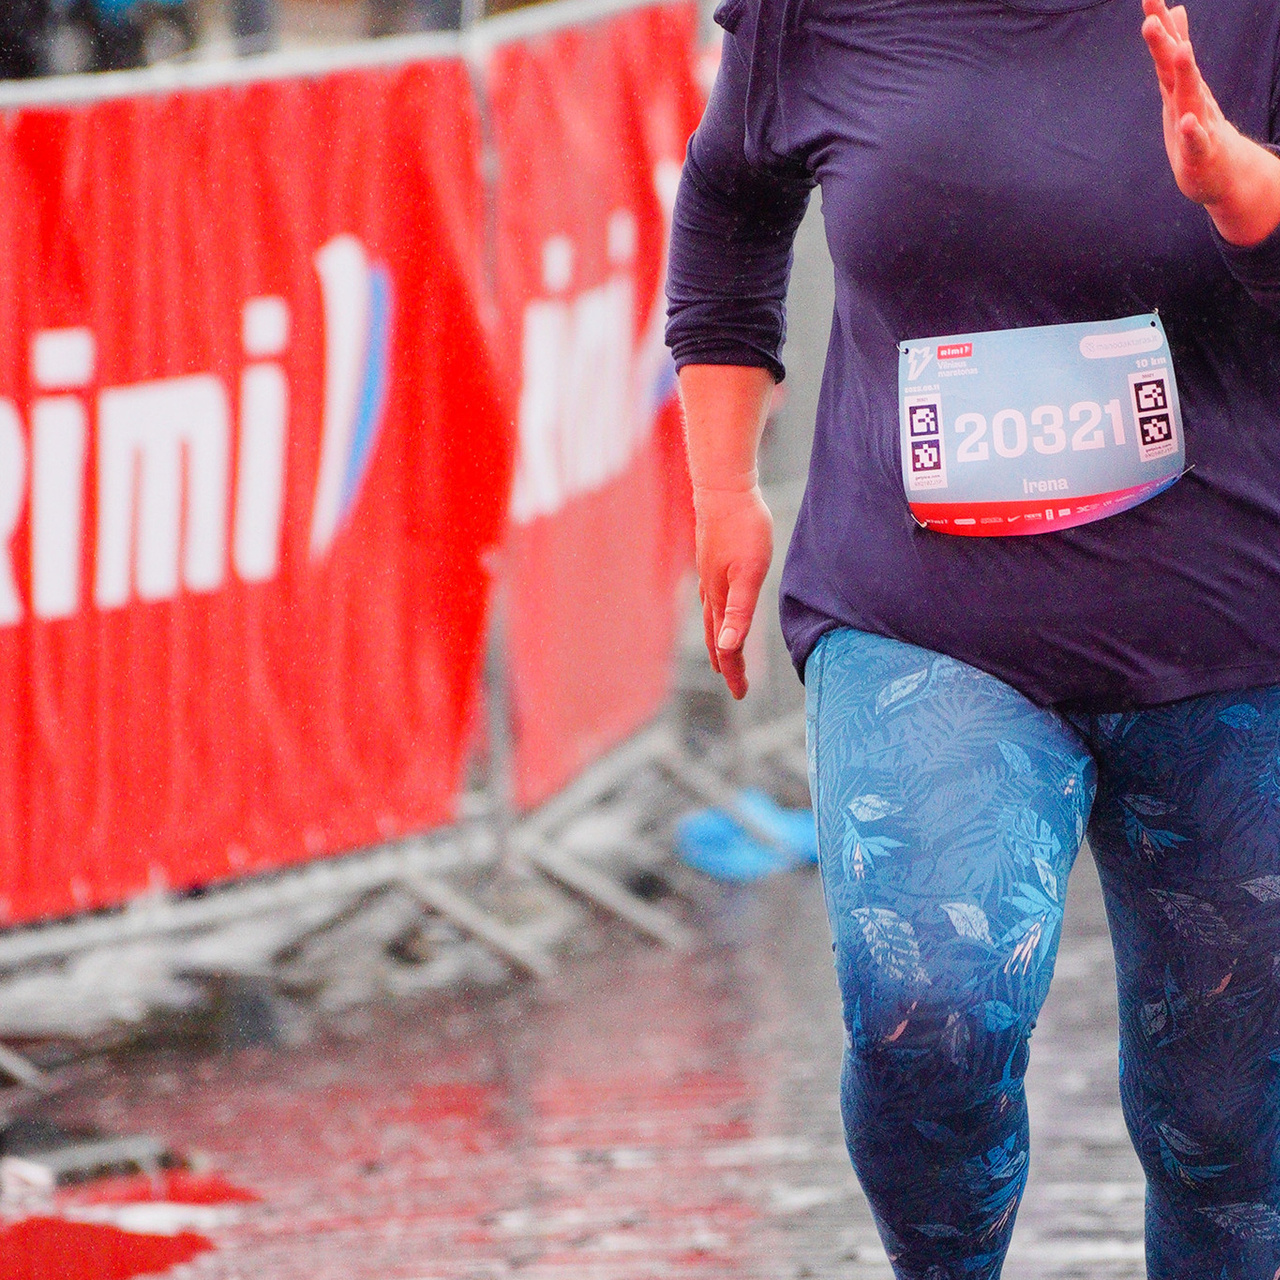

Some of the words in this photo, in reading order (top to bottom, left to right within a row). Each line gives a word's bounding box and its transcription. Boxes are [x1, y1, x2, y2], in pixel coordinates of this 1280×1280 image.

[1135, 358, 1148, 368] 10
[1150, 357, 1167, 366] km
[954, 398, 1126, 463] 20321
[1023, 476, 1069, 494] Irena
